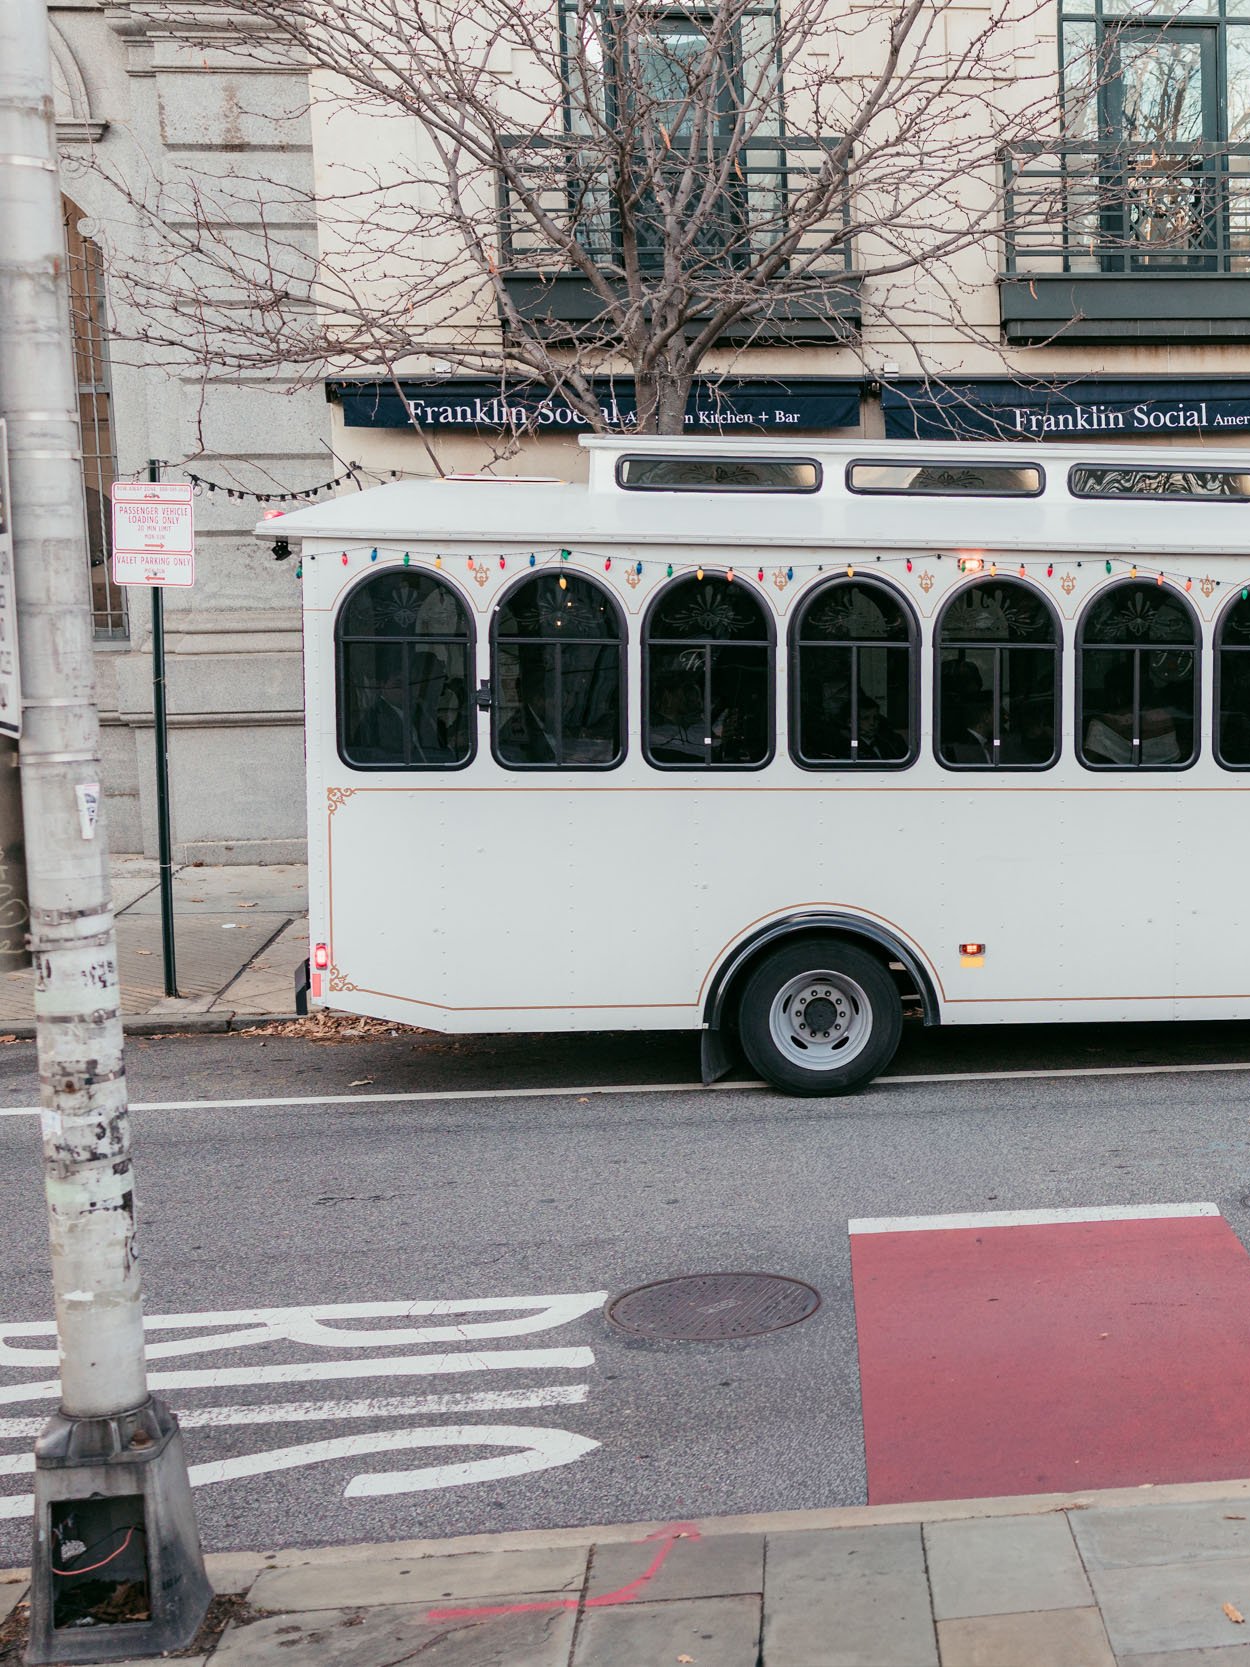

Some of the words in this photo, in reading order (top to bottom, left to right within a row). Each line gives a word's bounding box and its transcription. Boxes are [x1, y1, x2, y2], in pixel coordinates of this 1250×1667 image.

[407, 398, 527, 424] Franklin
[538, 399, 619, 424] Socal
[699, 410, 753, 424] Kitchen
[774, 410, 800, 423] Bar
[1014, 405, 1125, 431] Franklin
[1133, 403, 1208, 427] Social
[119, 506, 159, 515] PASSENGER
[162, 507, 188, 516] VEHICLE
[128, 516, 159, 524] LOADING
[163, 516, 180, 525] ONLY
[117, 556, 137, 564] VALET
[141, 557, 171, 565] PARKING
[174, 557, 191, 566] ONLY
